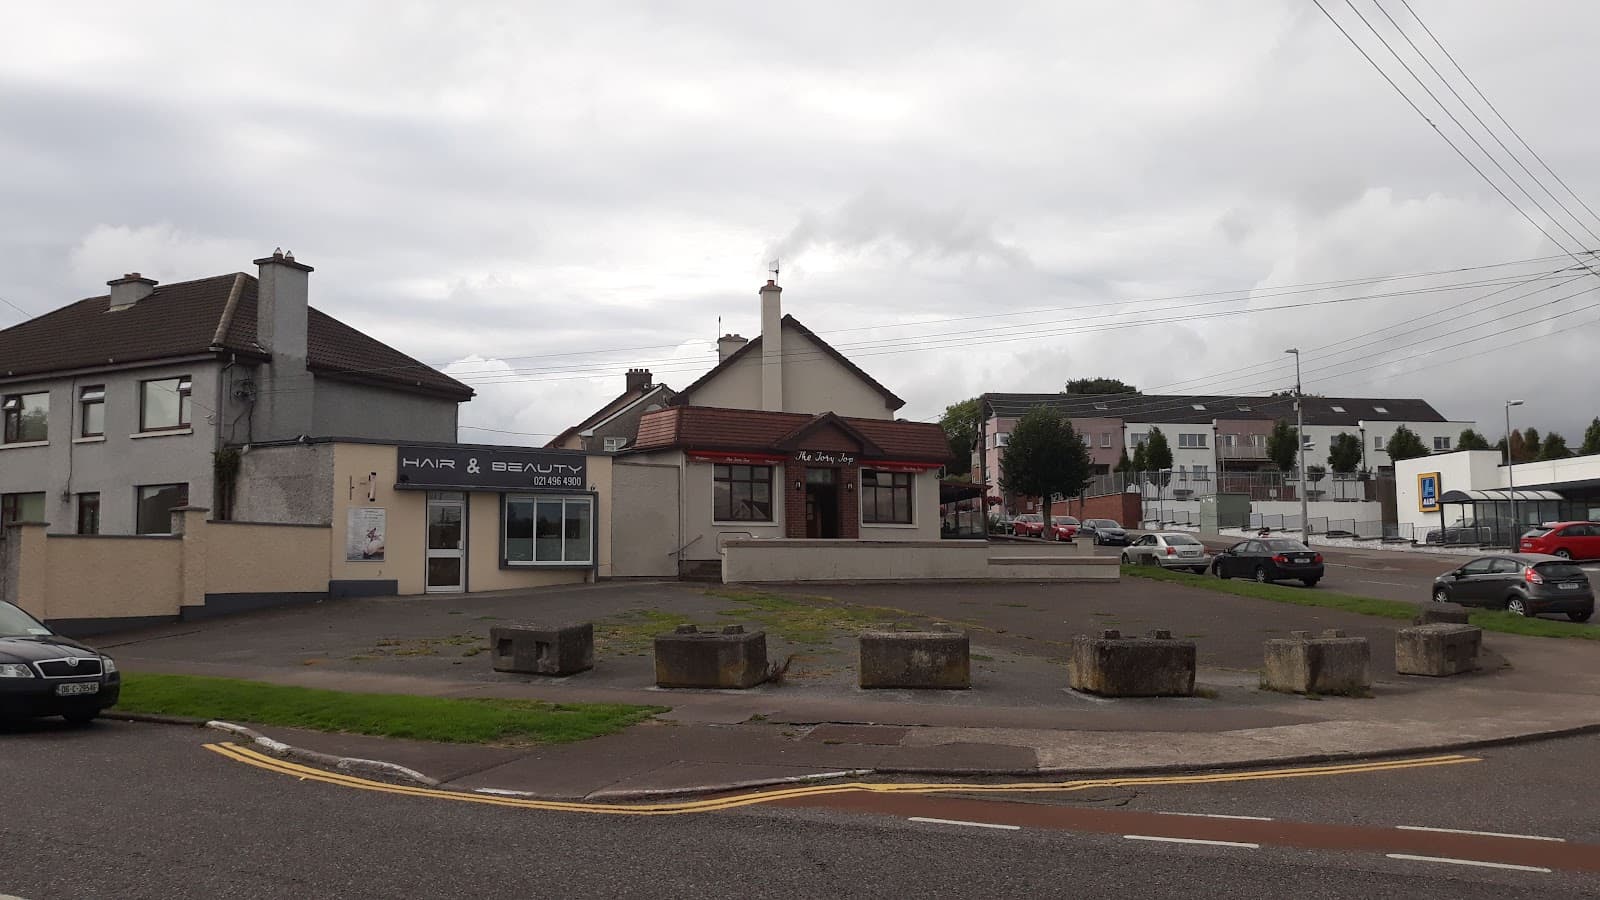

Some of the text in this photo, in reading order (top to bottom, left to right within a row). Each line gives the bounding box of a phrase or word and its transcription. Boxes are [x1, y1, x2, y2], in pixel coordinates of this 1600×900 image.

[794, 450, 854, 466] The Tory Top
[402, 457, 583, 475] HAIR & BEAUTY
[533, 475, 582, 487] 021 496 4900
[1423, 497, 1435, 505] ALDI
